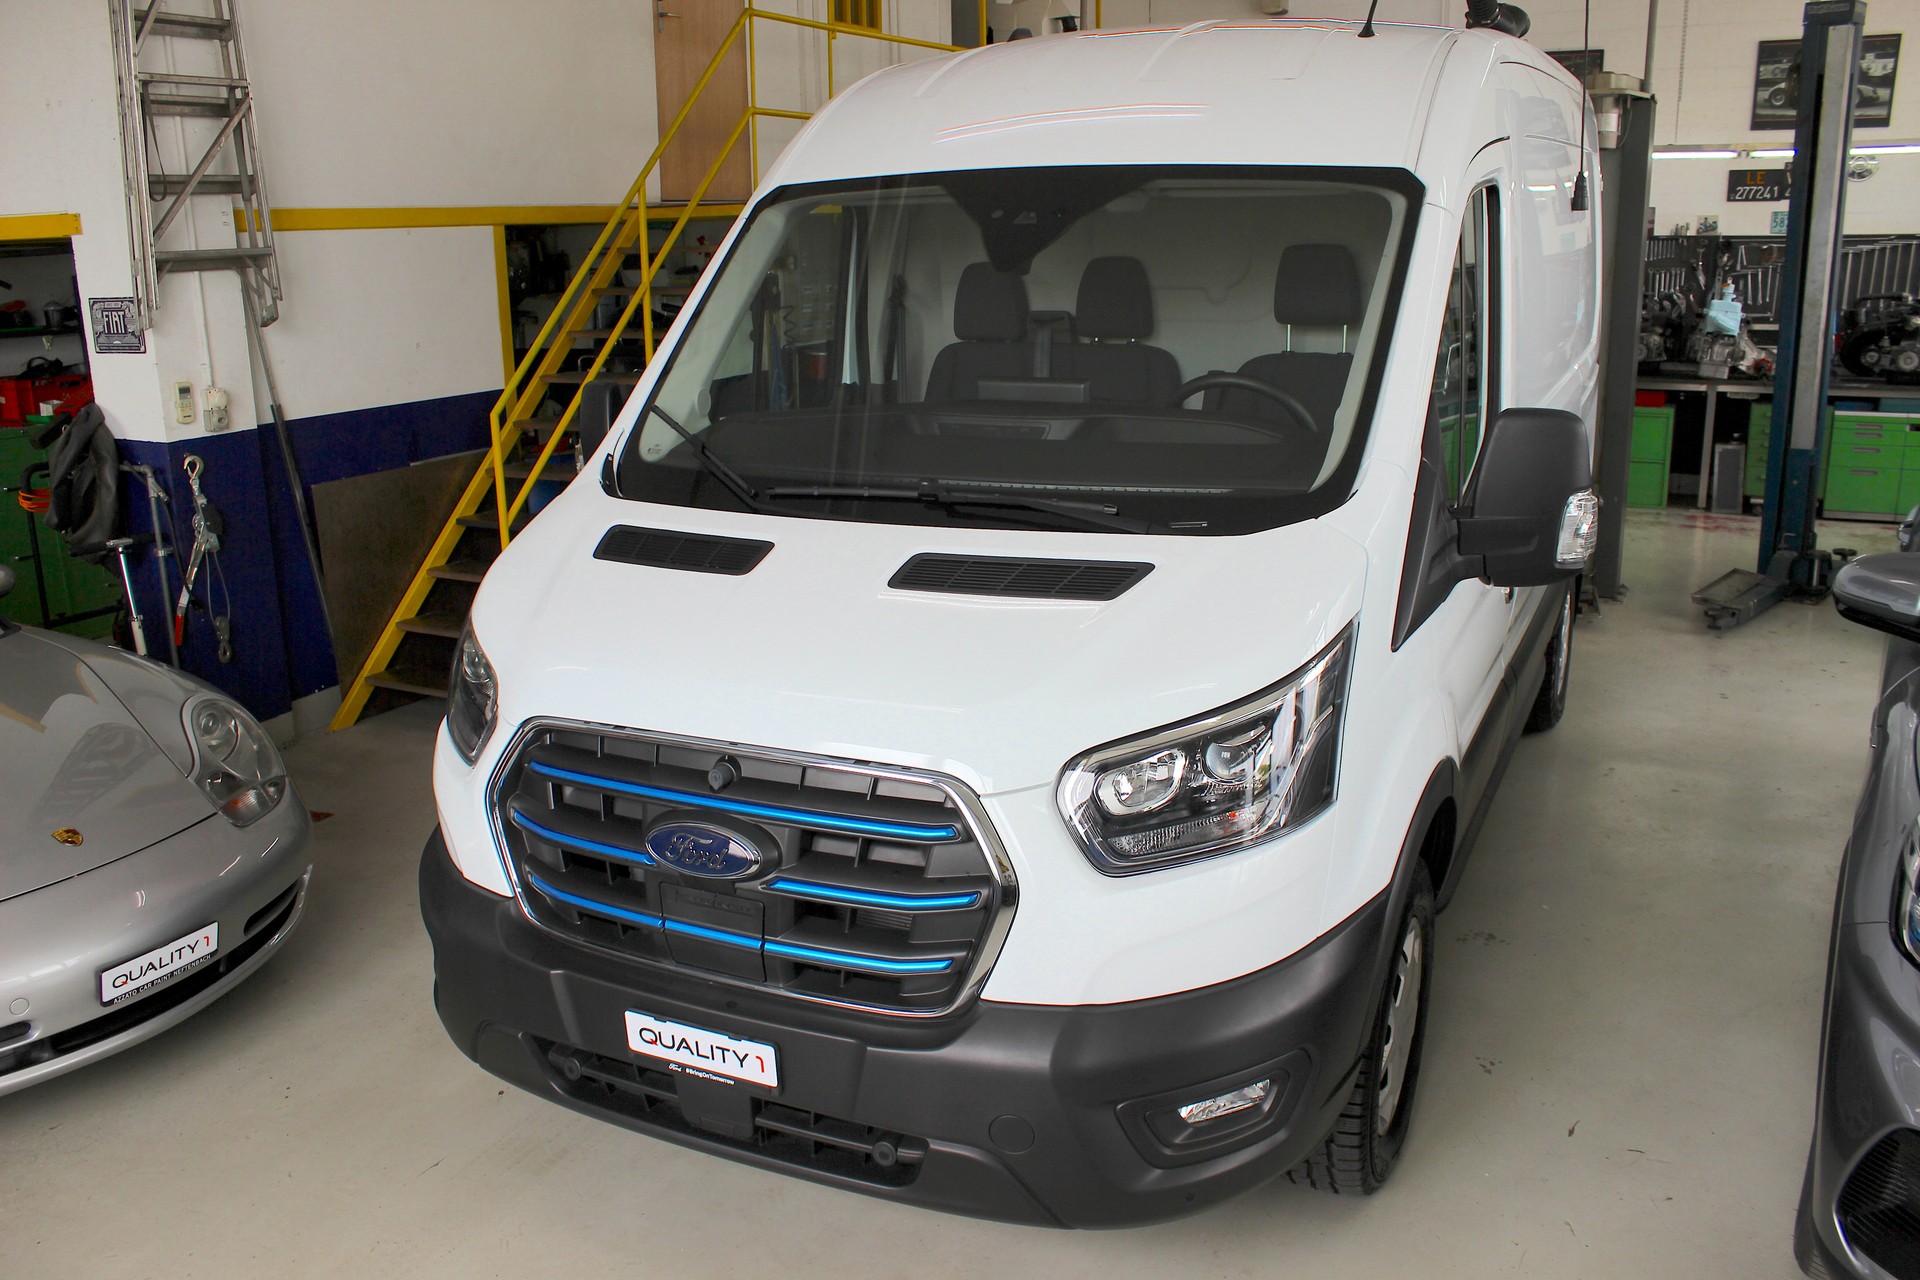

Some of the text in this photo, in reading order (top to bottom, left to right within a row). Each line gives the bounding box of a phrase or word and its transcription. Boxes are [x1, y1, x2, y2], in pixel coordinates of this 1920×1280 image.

[1735, 186, 1778, 199] 277241
[1747, 171, 1767, 184] LE
[102, 311, 125, 333] FIAT
[665, 832, 729, 870] Ford
[112, 935, 210, 989] QUALITY 1
[113, 954, 211, 1004] AZZATO CAR PAINT NEFTENBACH
[639, 1027, 765, 1073] QUALITY 1
